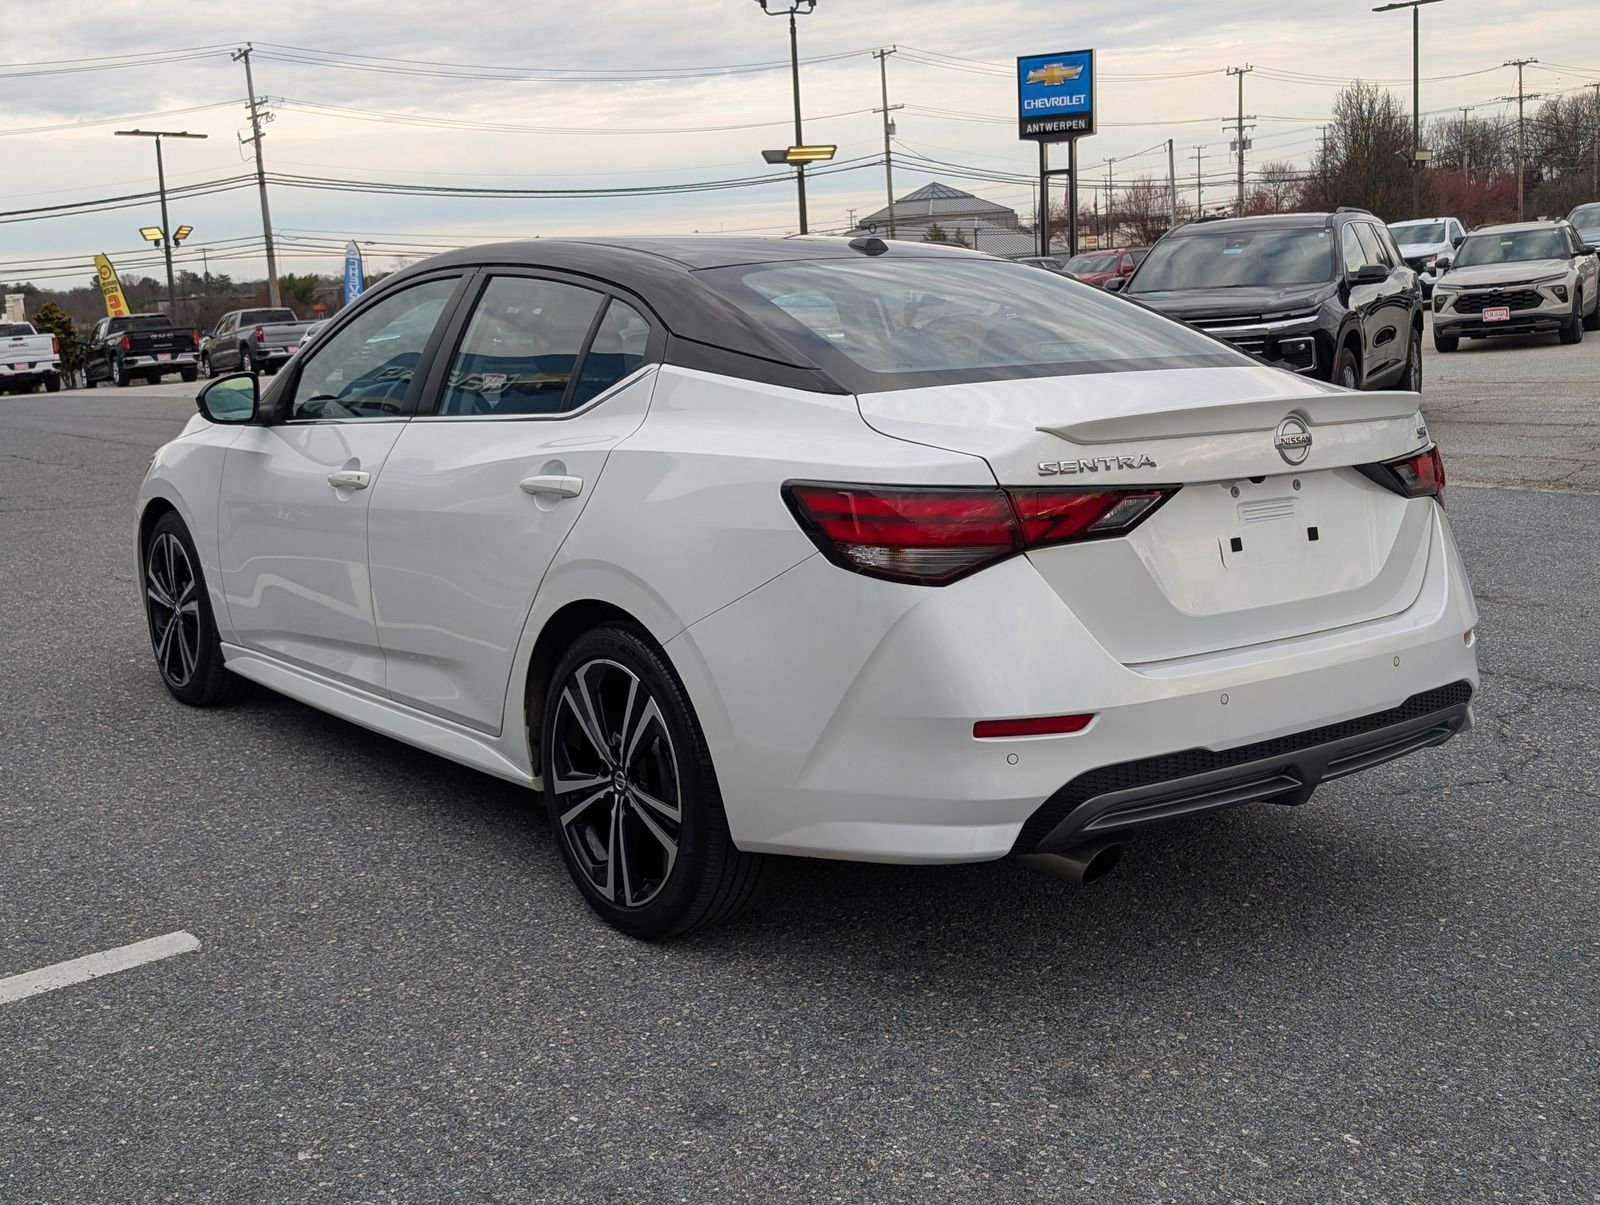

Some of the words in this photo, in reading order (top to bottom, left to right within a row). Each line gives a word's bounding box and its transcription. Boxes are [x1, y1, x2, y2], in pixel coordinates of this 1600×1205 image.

[1024, 94, 1086, 109] CHEVROLET
[1026, 120, 1086, 133] ANTWERPEN
[1280, 435, 1311, 446] NISSAN
[1038, 453, 1158, 477] SENTRA
